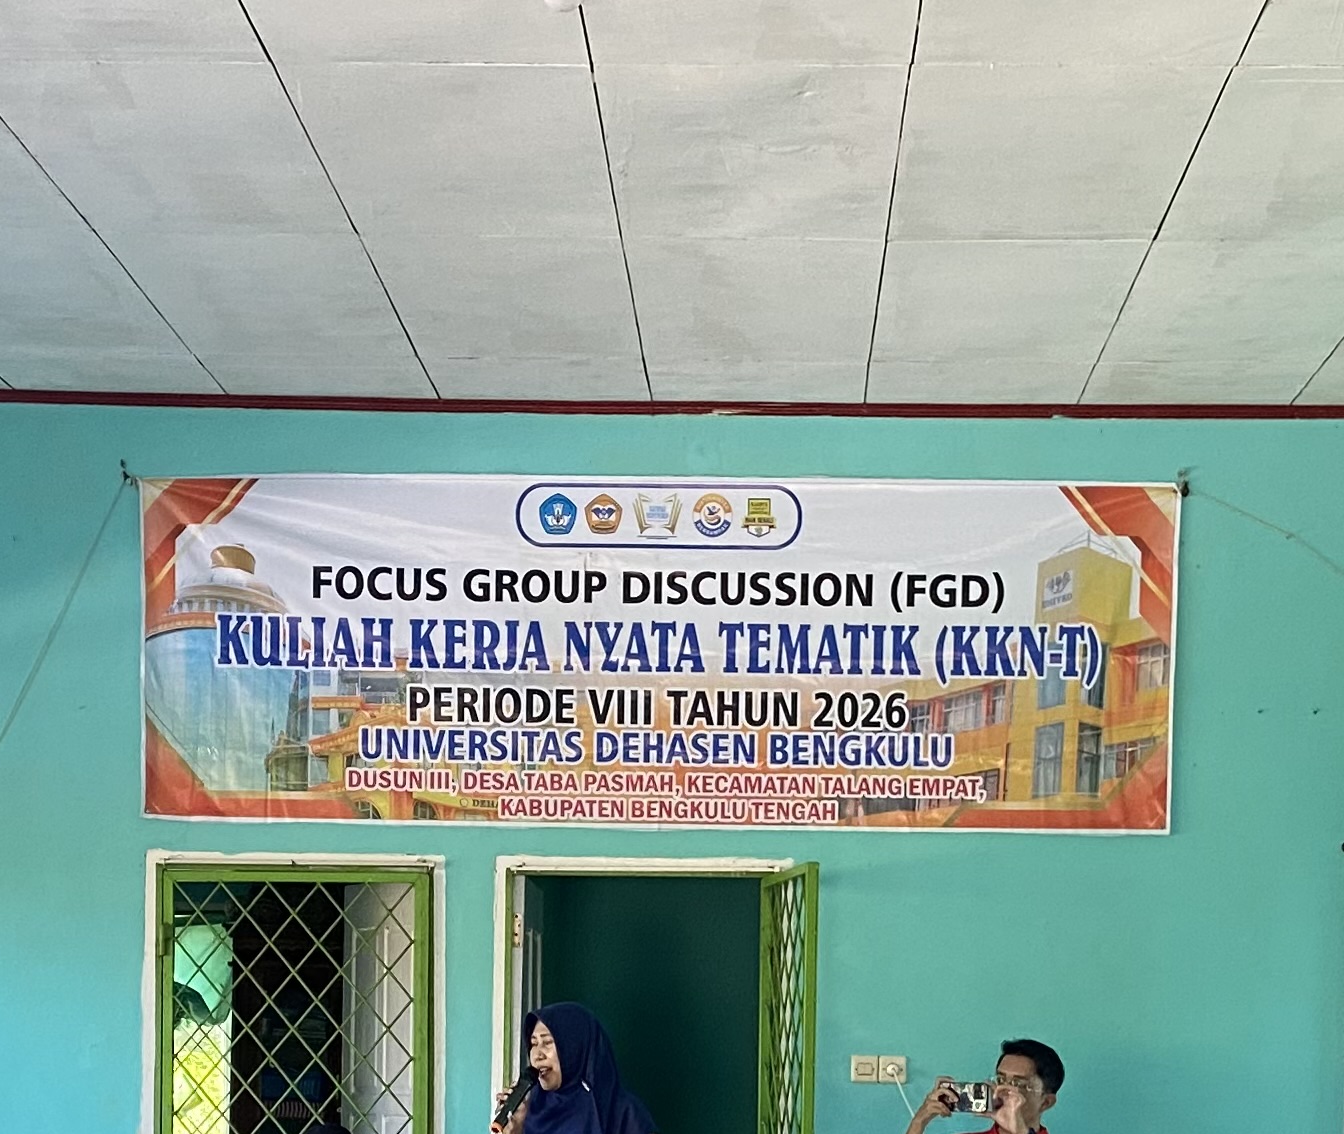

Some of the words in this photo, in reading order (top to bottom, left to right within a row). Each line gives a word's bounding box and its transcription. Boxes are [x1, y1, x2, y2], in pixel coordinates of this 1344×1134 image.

[312, 565, 447, 601] FOCUS
[463, 569, 607, 603] GROUP
[622, 571, 873, 607] DISCUSSION
[890, 571, 1005, 614] (FGD)
[217, 614, 394, 668] KULIAH
[409, 619, 550, 672] KERJA
[563, 620, 705, 673] NYATA
[718, 621, 921, 676] TEMATIK
[935, 625, 1102, 687] (KKN-T)
[409, 686, 575, 724] PERIODE
[588, 689, 652, 725] VIII
[666, 690, 798, 727] TAHUN
[814, 692, 906, 728] 2026
[361, 728, 582, 763] UNIVERSITAS
[596, 731, 755, 764] DEHASEN
[769, 734, 953, 767] BENGKULU
[348, 770, 423, 789] DUSUN
[429, 771, 457, 793] III,
[463, 772, 519, 791] DESA
[525, 773, 578, 792] TABA
[583, 774, 680, 797] PASMAH,
[687, 775, 816, 795] KECAMATAN
[819, 776, 902, 796] TALANG
[909, 778, 986, 801] EMPAT,
[500, 799, 624, 818] KABUPATEN
[631, 800, 748, 820] BENGKULU
[751, 802, 837, 821] TENGAH
